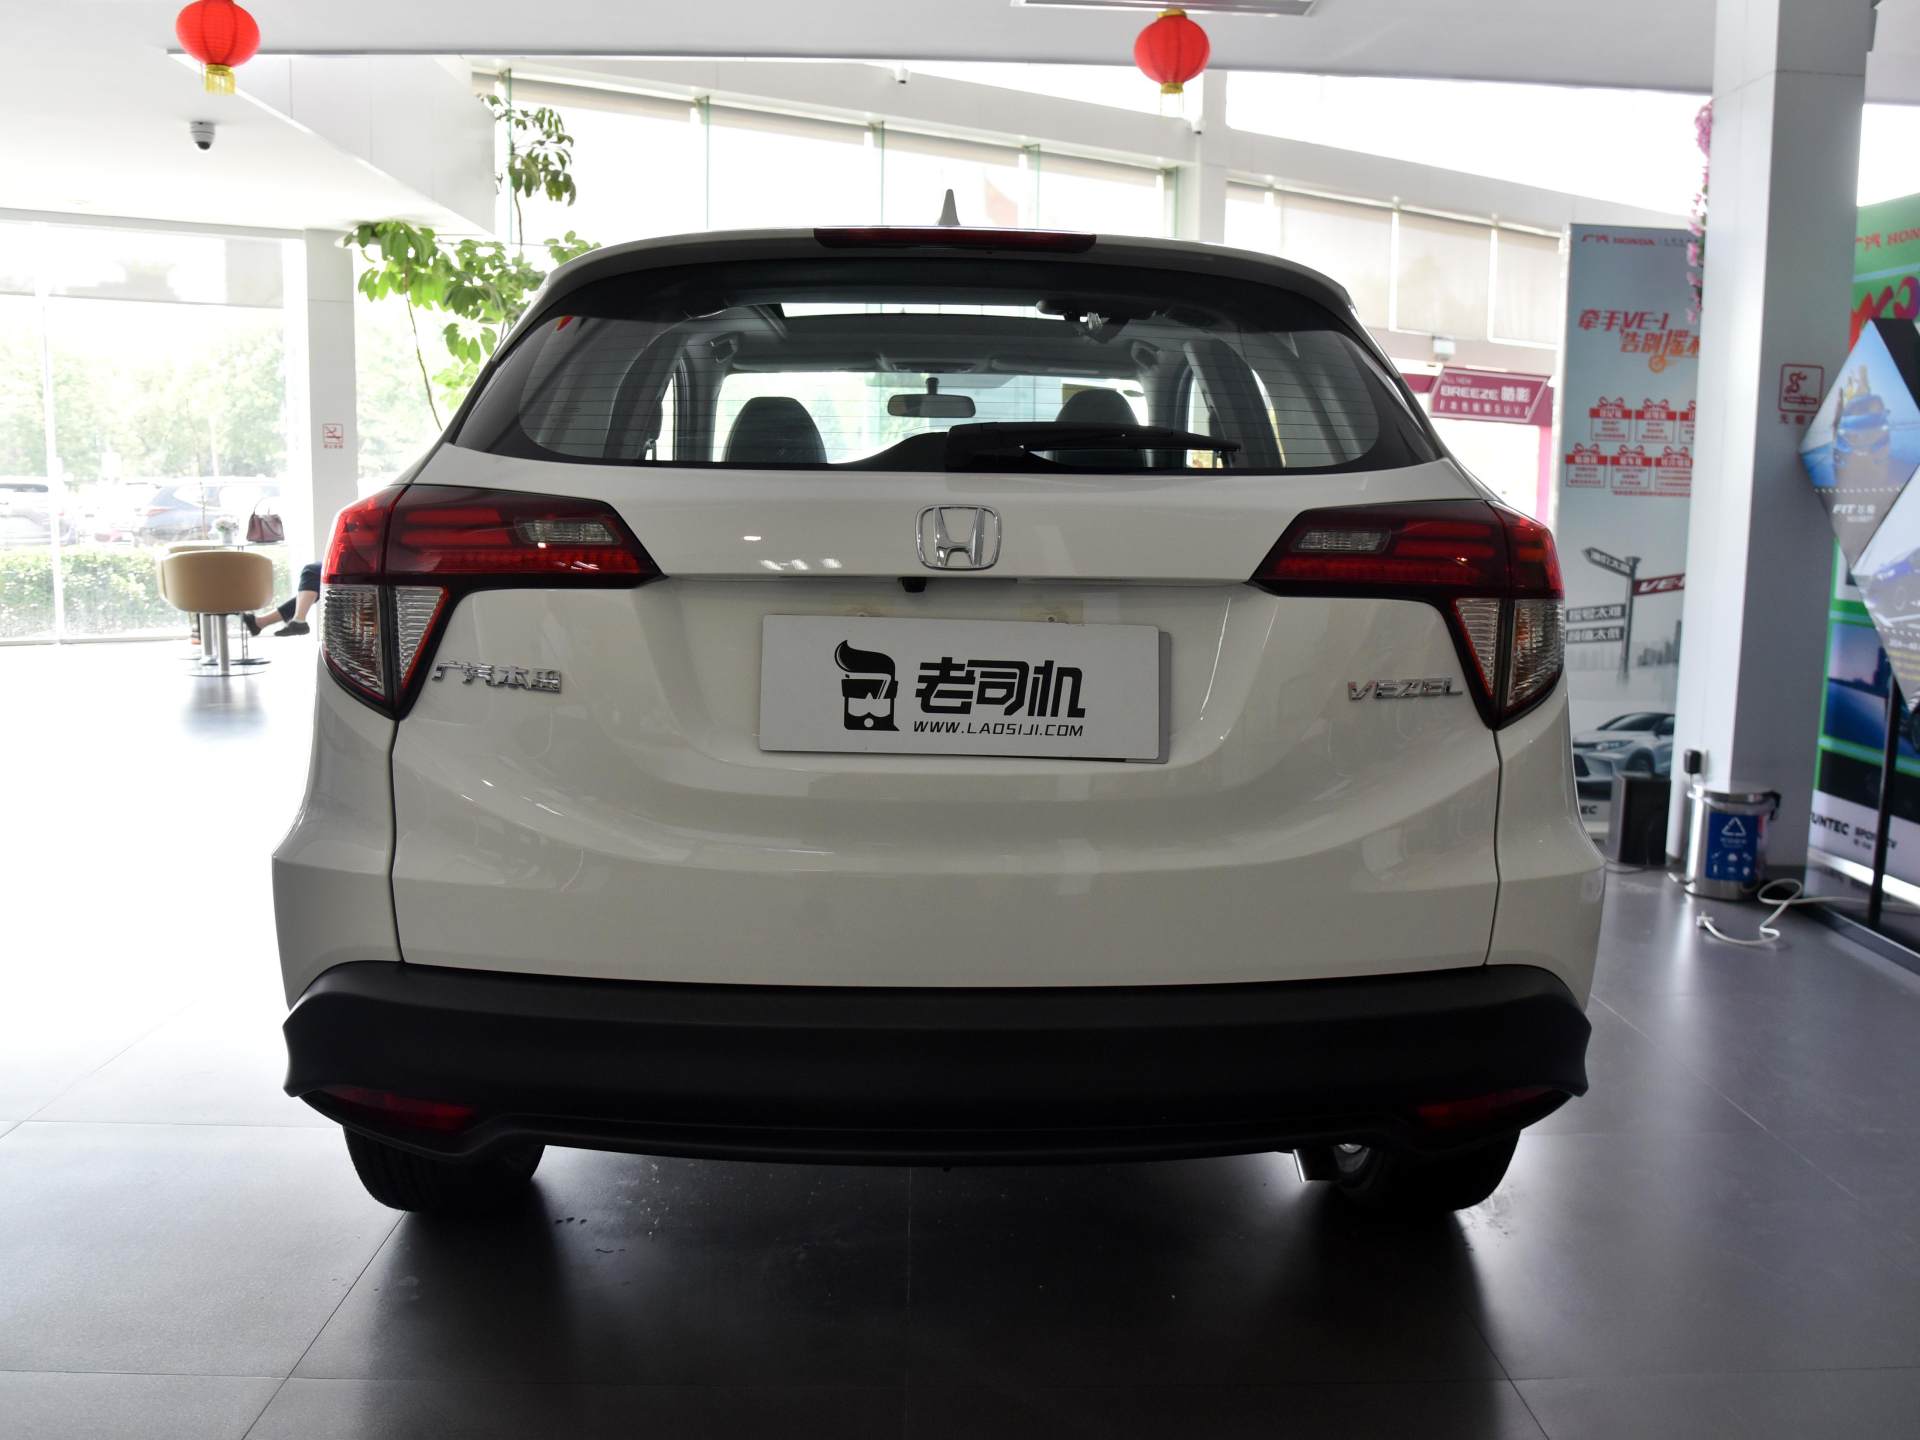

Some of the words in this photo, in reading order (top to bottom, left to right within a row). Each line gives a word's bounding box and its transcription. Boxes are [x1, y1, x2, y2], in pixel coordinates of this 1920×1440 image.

[1614, 236, 1656, 246] HONDA
[432, 661, 562, 694] 广汽本田
[914, 656, 1086, 719] 老司机
[1347, 677, 1463, 701] VEZEL
[913, 720, 1084, 738] WWW.LAOSIJI.COM
